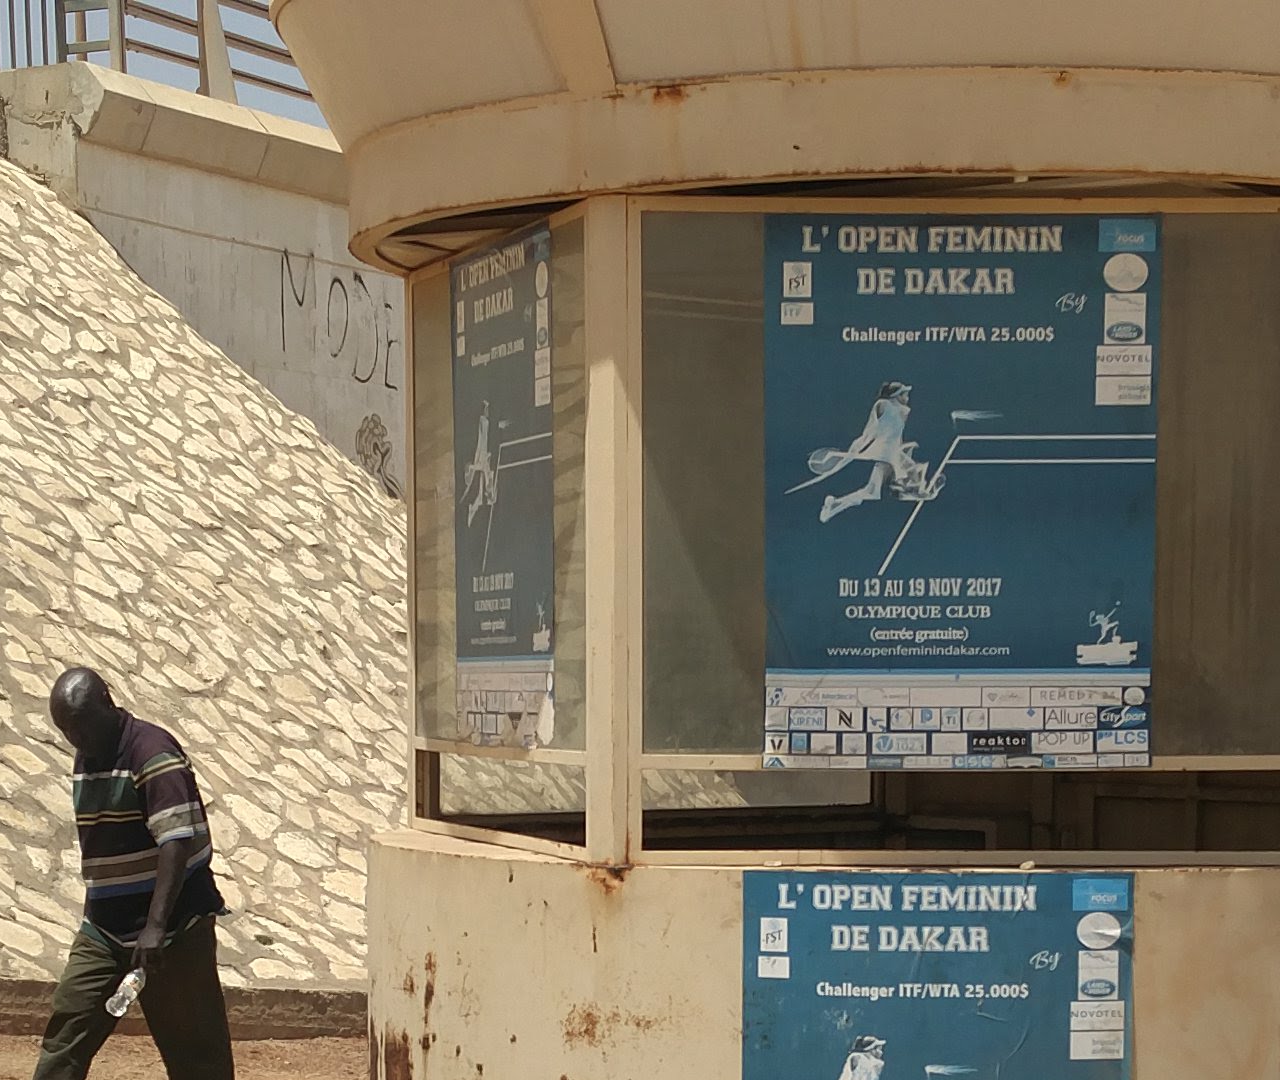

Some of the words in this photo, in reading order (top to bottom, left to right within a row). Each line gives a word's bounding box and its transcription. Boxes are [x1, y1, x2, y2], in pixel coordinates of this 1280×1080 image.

[802, 225, 829, 253] L'
[838, 225, 918, 253] OPEN
[928, 225, 1063, 253] FEMININ
[857, 267, 896, 295] DE
[905, 267, 1016, 296] DAKAR
[1055, 292, 1088, 314] By
[842, 325, 921, 346] Challenger
[925, 326, 986, 344] ITF/WTA
[991, 326, 1054, 343] 25.000$
[1097, 354, 1152, 362] NOVOTEL
[839, 578, 858, 597] DU
[864, 578, 880, 597] 13
[884, 578, 903, 597] AU
[909, 578, 925, 597] 19
[929, 578, 962, 597] NOV
[967, 578, 1002, 597] 2017
[845, 605, 941, 620] OLYMPIQUE
[945, 605, 991, 619] CLUB
[870, 626, 913, 641] (entrée
[915, 626, 969, 642] gratuite)
[827, 644, 1010, 658] www.openfeminindakar.com
[1046, 709, 1097, 724] Allure
[972, 735, 1026, 746] reaktor
[1037, 731, 1068, 746] POP
[1073, 732, 1090, 745] UP
[1114, 731, 1147, 745] LCS
[777, 883, 804, 909] L'
[812, 884, 893, 911] OPEN
[902, 885, 1037, 912] FEMININ
[830, 925, 871, 952] DE
[878, 926, 989, 952] DAKAR
[1029, 949, 1062, 971] By
[816, 982, 895, 1001] Challenger
[898, 983, 959, 999] ITF/WTA
[964, 983, 1029, 999] 25.000$
[1071, 1009, 1123, 1018] NOVOTEL
